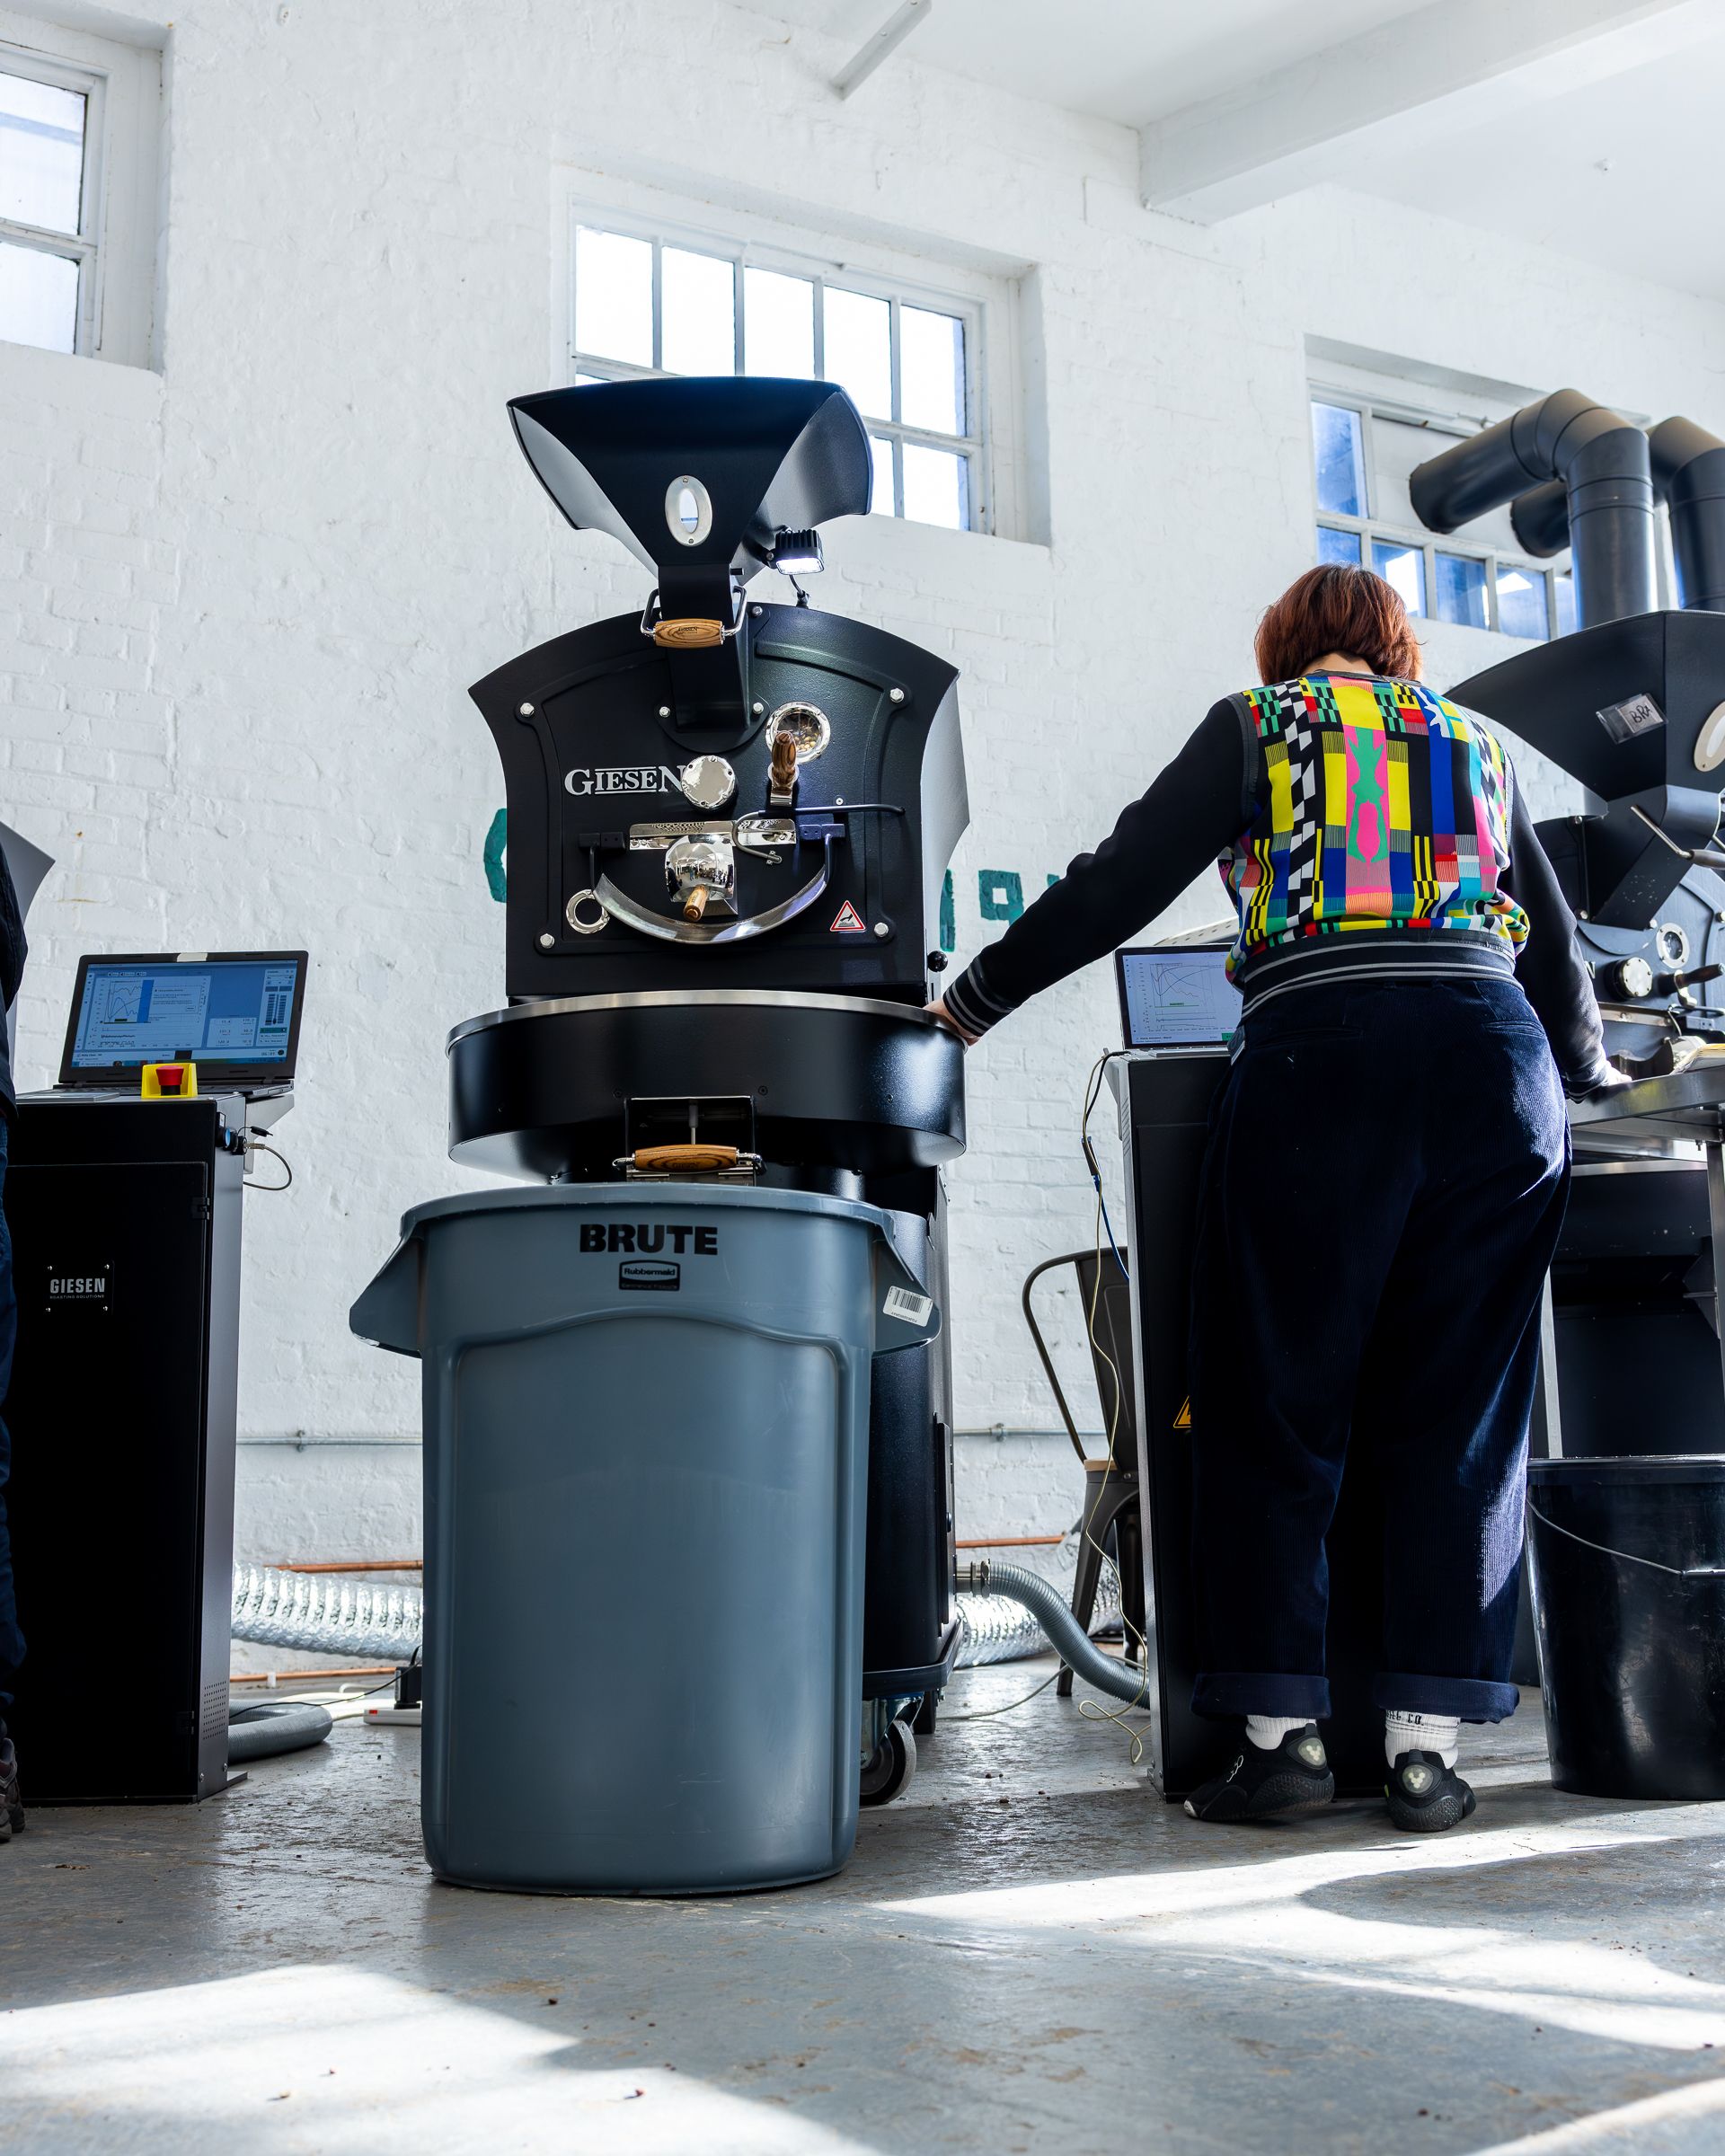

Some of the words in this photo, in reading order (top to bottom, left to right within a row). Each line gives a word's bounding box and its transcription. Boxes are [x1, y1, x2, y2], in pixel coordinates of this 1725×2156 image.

[564, 765, 687, 796] GIESEN
[579, 1224, 719, 1256] BRUTE
[624, 1267, 676, 1277] Rubbermaid
[49, 1277, 105, 1294] GIESEN
